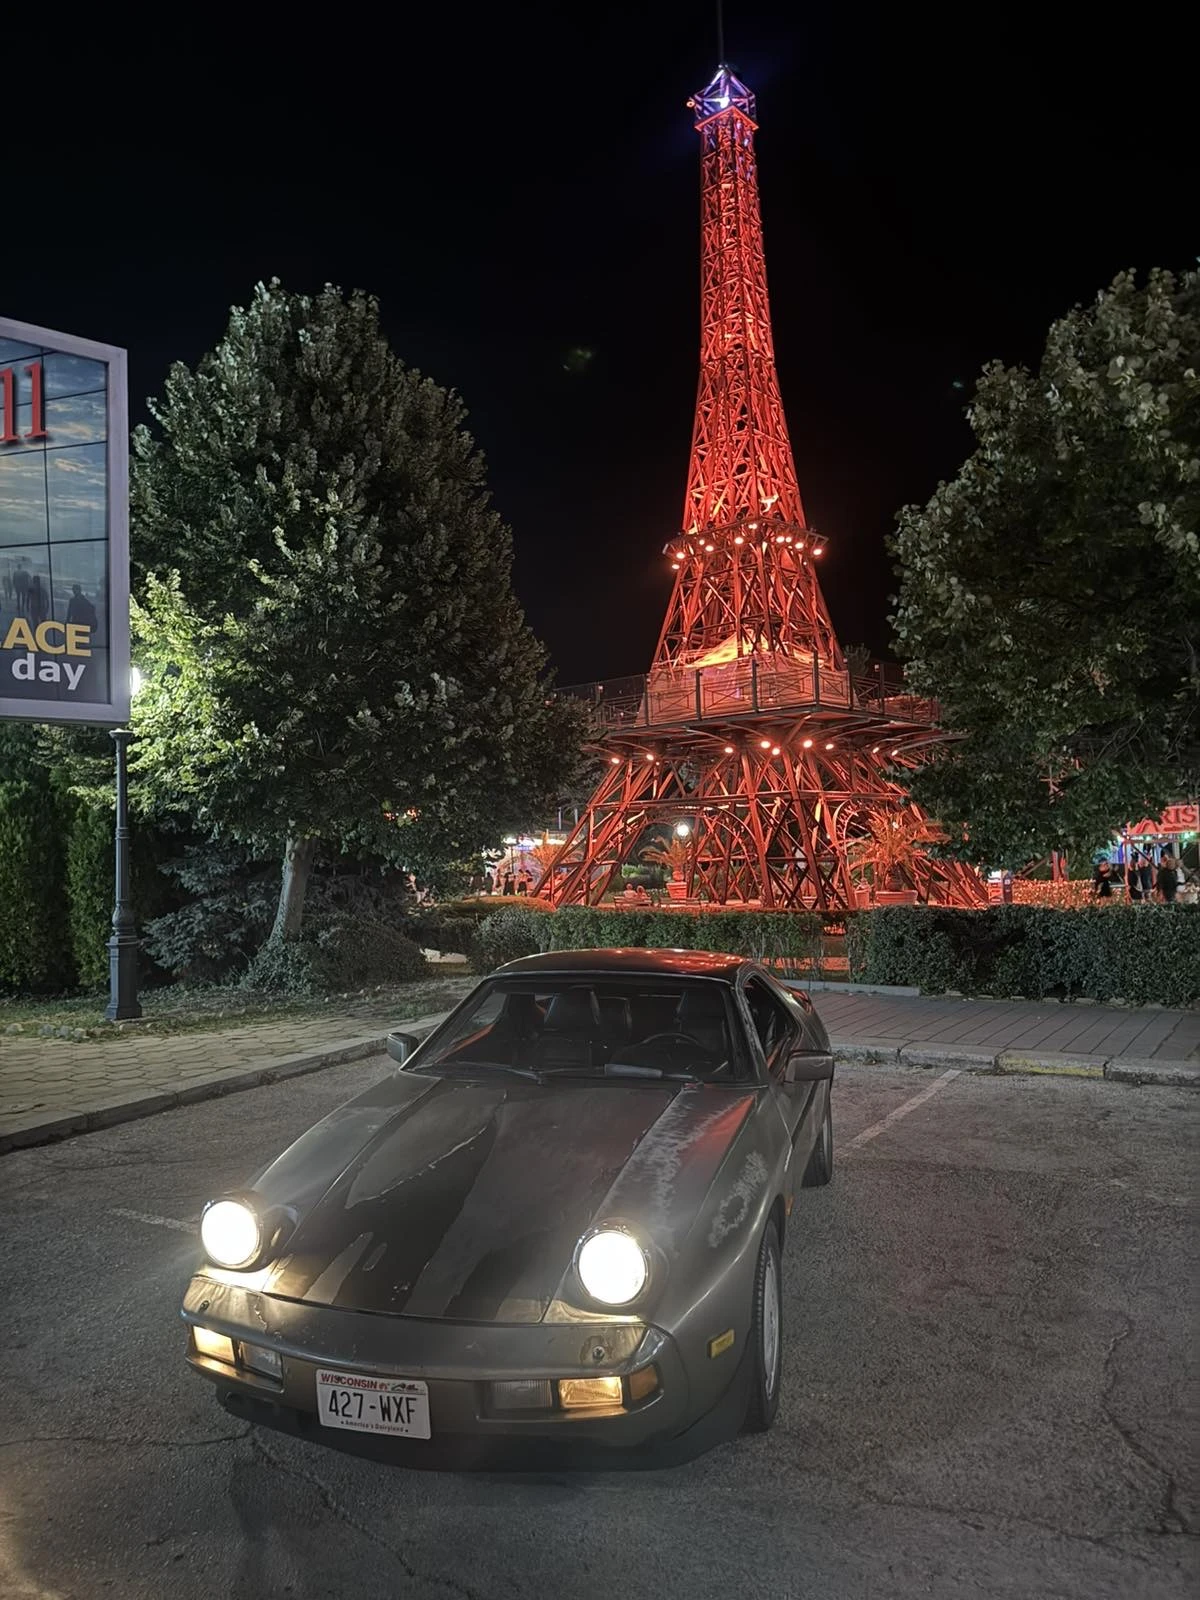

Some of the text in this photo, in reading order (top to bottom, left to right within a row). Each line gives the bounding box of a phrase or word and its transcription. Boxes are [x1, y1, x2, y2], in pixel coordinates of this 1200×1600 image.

[0, 617, 92, 657] ACE
[11, 653, 86, 690] day
[321, 1374, 377, 1389] WISCONSIN
[329, 1390, 417, 1424] 427-WXF
